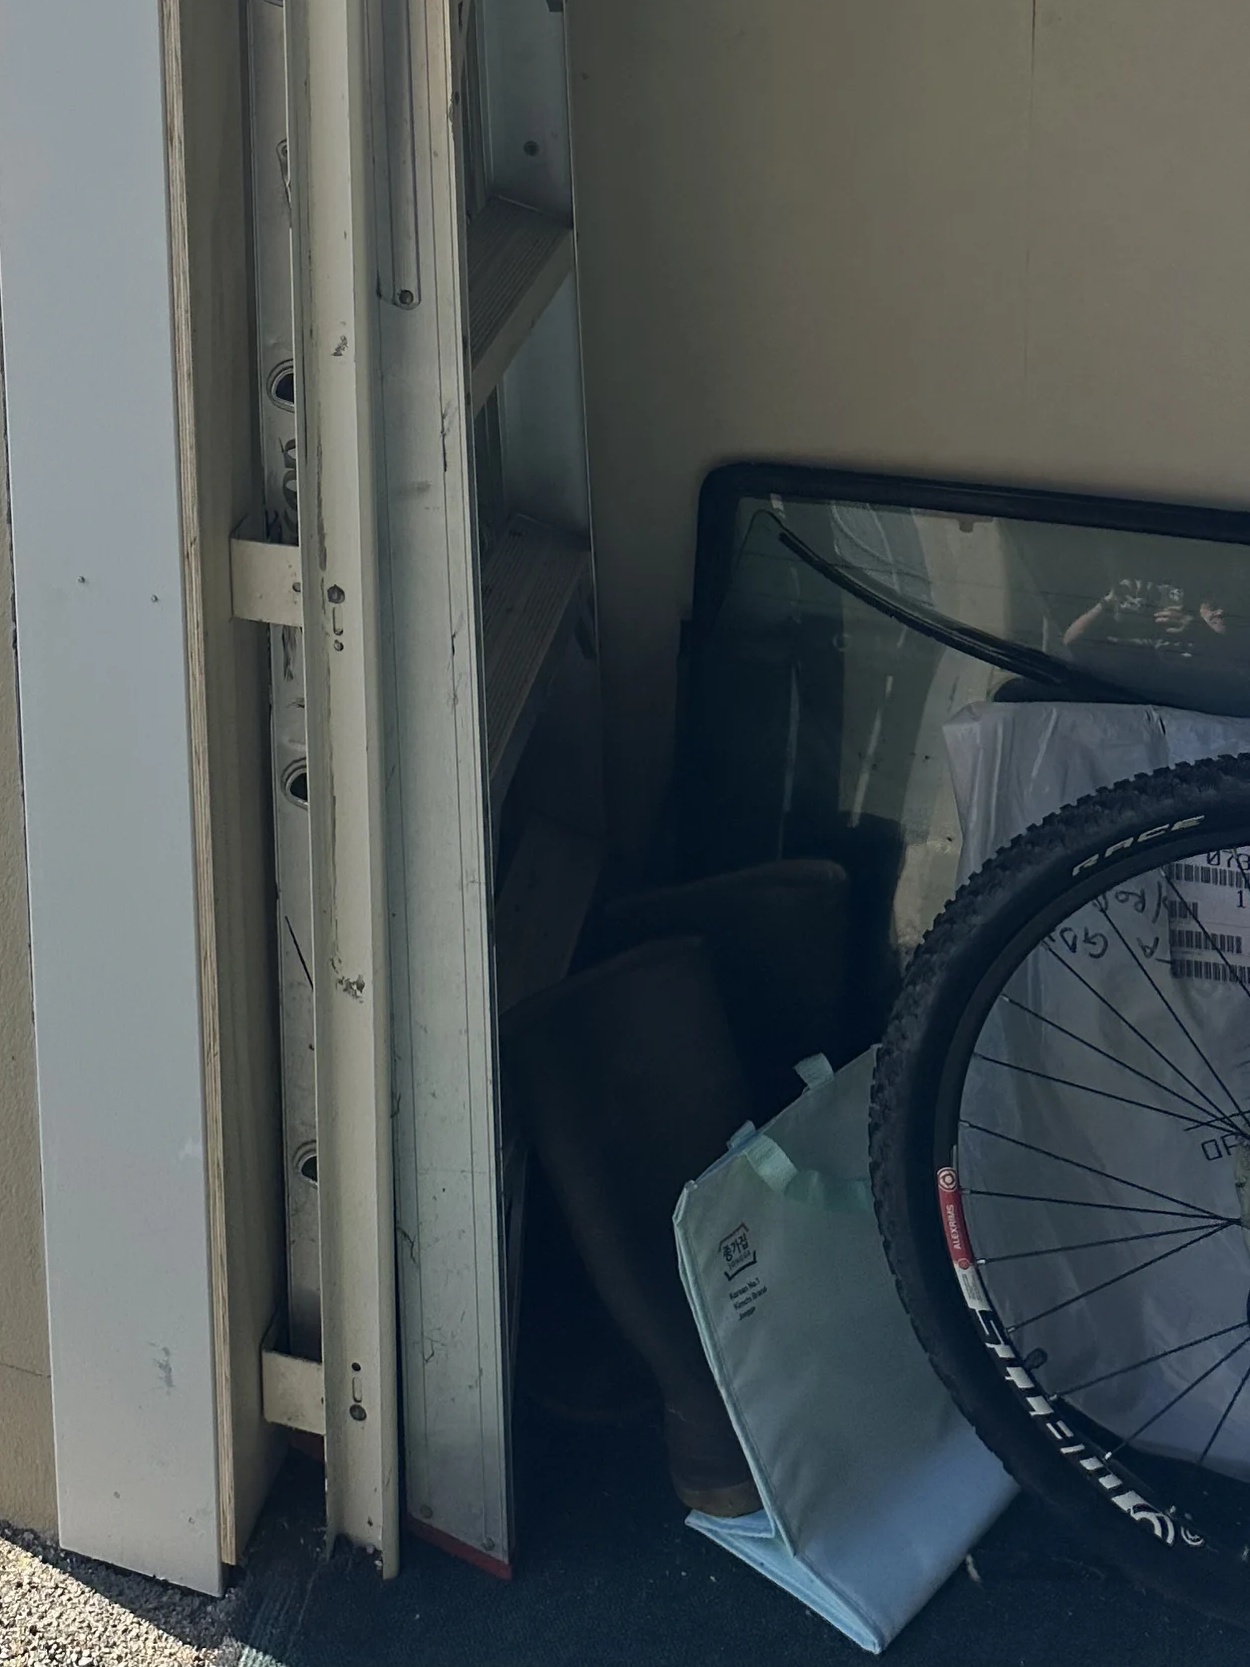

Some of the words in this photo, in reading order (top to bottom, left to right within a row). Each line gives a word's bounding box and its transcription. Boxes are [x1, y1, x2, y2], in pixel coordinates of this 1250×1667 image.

[1072, 815, 1205, 876] RACE
[723, 1233, 749, 1262] 종가집
[946, 1204, 962, 1250] ALEXRIMS
